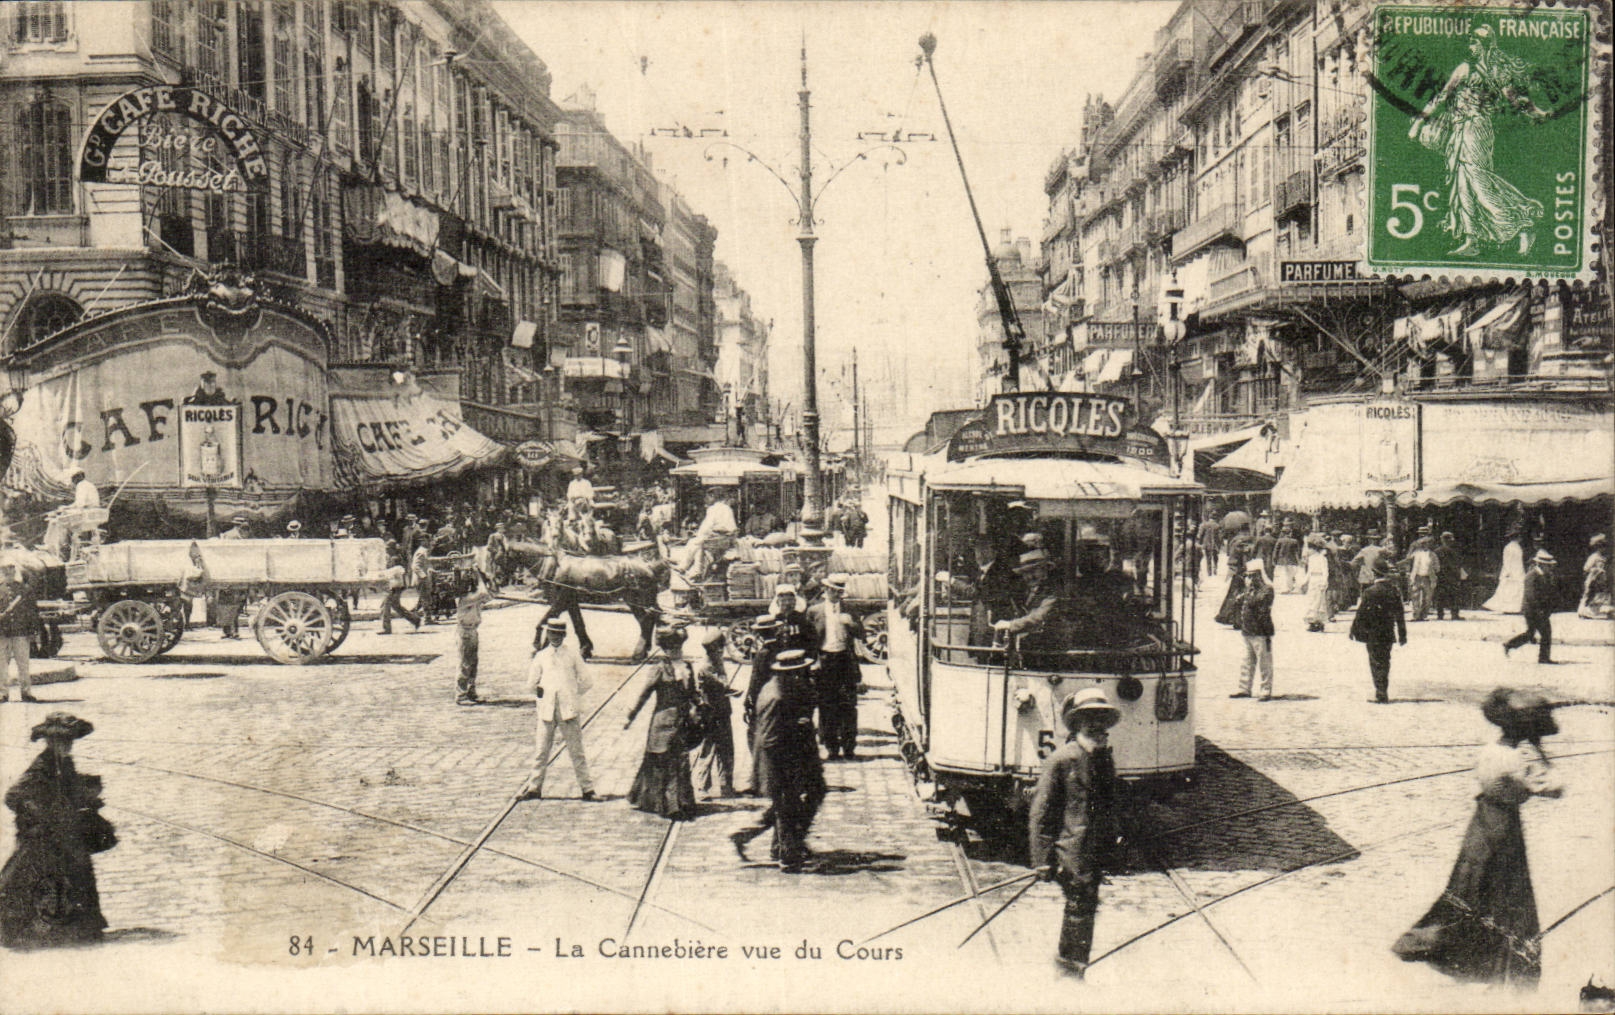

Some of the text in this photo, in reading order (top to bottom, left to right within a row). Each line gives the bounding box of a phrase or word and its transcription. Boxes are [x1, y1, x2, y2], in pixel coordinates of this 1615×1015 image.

[1499, 19, 1581, 40] FRANÇAISE
[101, 86, 177, 135] CAFE
[188, 90, 268, 180] RICHE
[1554, 171, 1576, 255] POSTES
[62, 398, 174, 461] CAF
[250, 395, 327, 450] RIC
